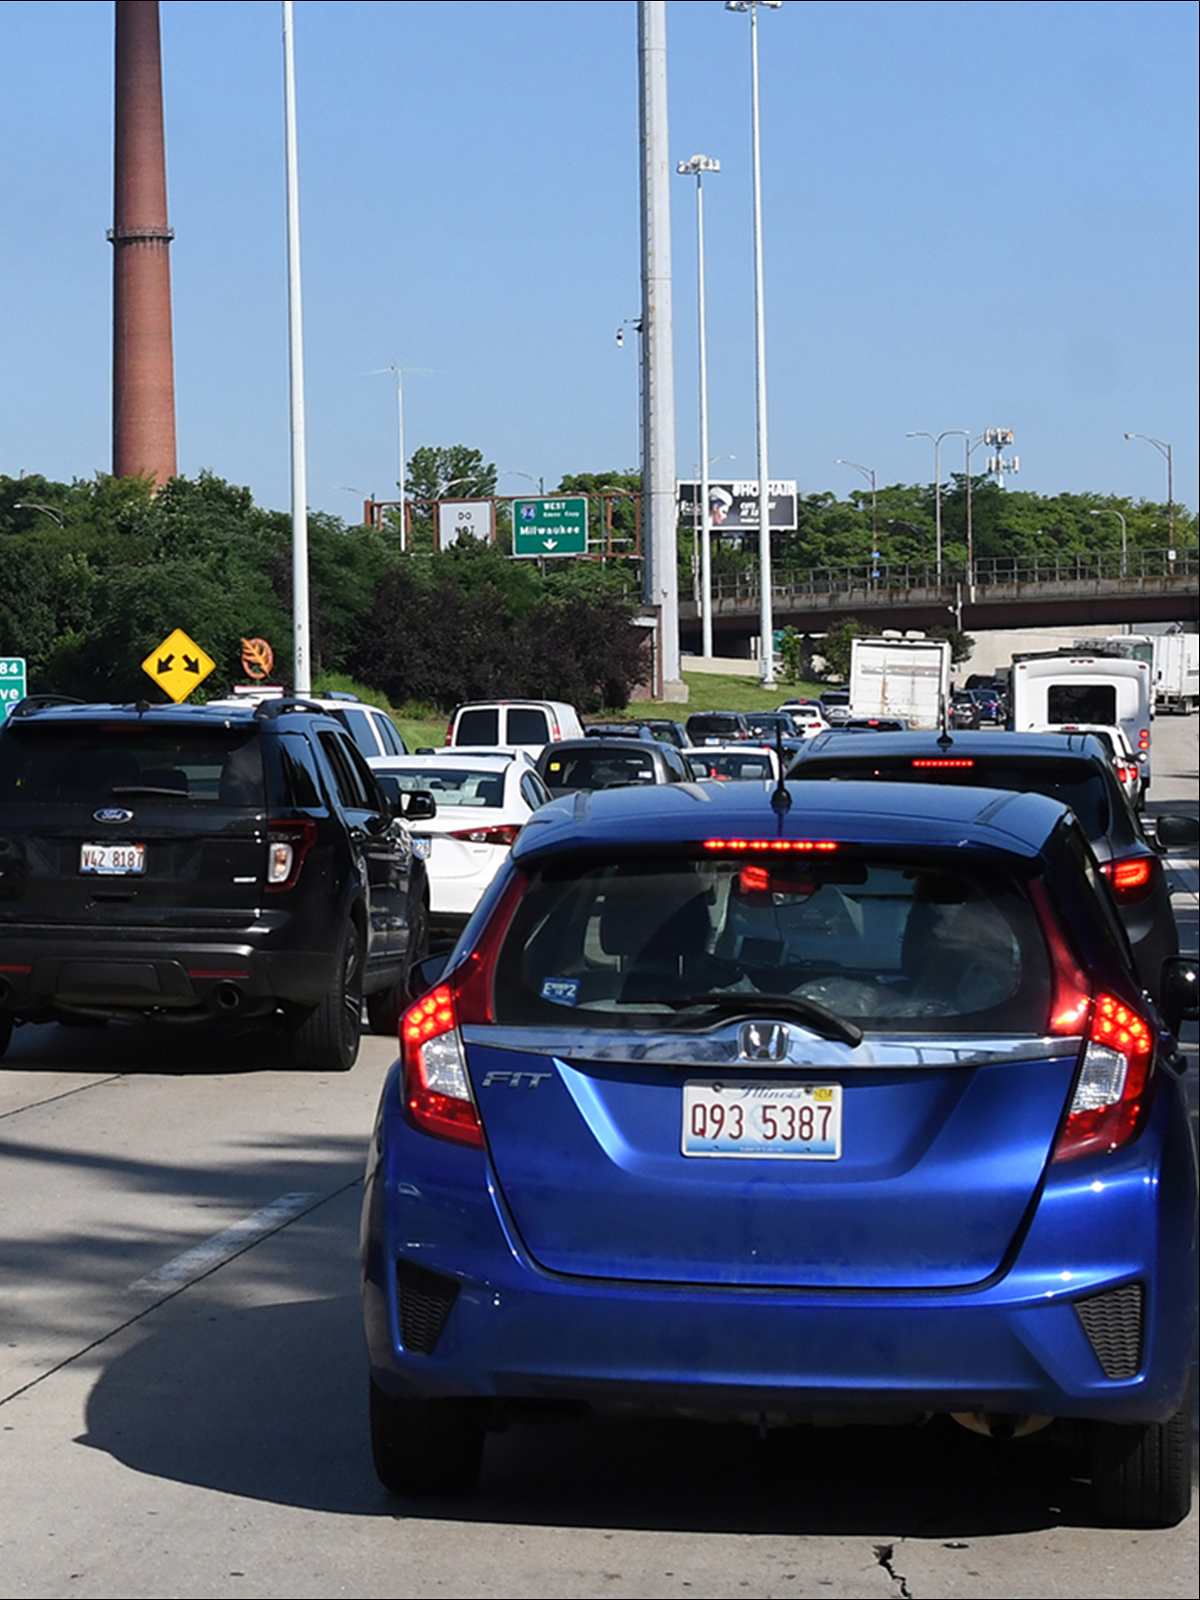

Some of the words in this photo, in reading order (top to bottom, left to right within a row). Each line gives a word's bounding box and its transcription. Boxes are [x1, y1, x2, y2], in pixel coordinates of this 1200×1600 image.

[732, 483, 796, 497] #HOHAIR
[520, 507, 537, 518] 94
[543, 502, 566, 510] WEST
[457, 511, 472, 521] DO
[519, 525, 580, 536] Milwaukee
[83, 850, 106, 868] V42
[112, 850, 144, 868] 8187
[482, 1071, 552, 1088] FIT
[741, 1085, 803, 1100] Illinois
[691, 1103, 744, 1140] Q93
[762, 1104, 833, 1142] 5387
